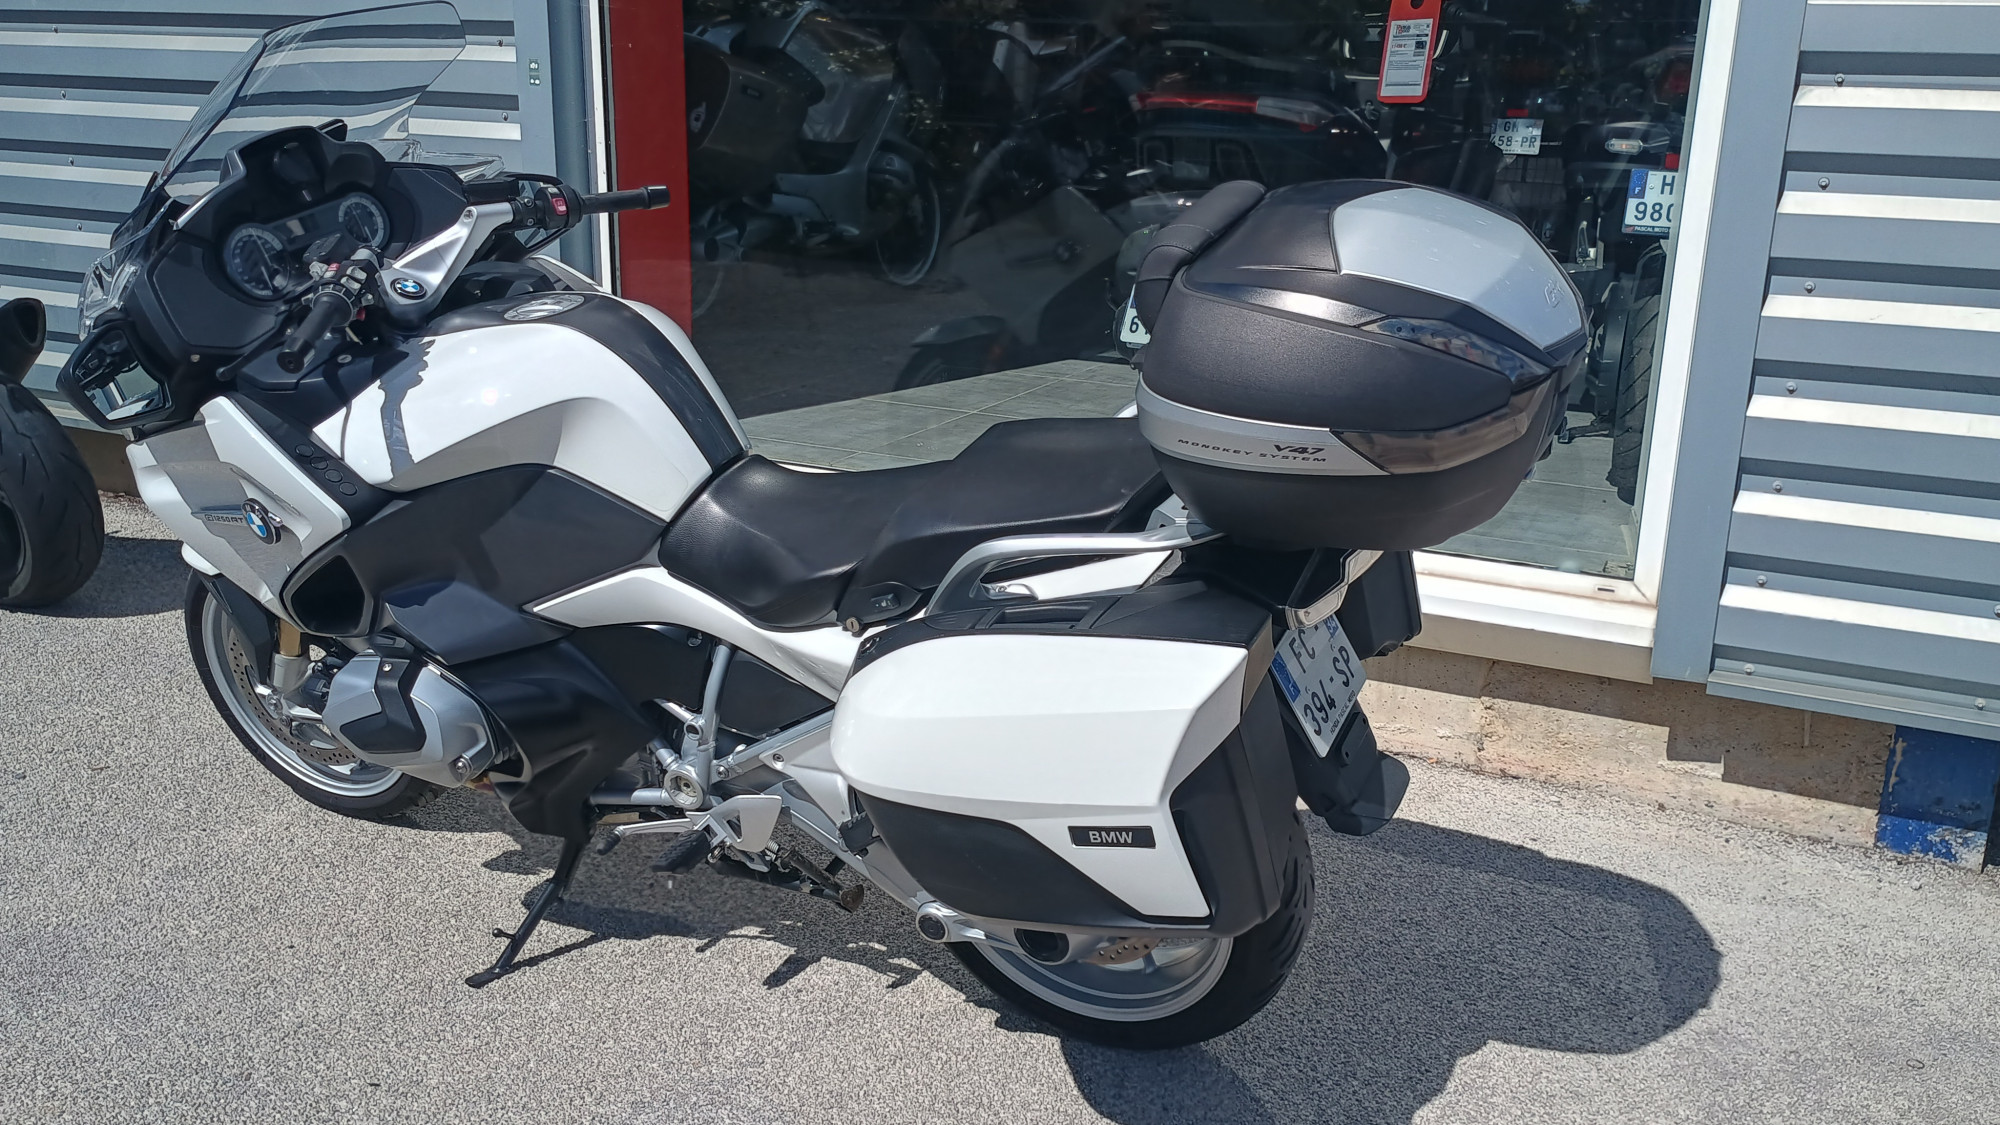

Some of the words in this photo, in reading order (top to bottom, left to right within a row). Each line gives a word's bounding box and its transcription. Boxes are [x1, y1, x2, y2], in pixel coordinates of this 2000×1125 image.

[1177, 438, 1254, 456] MONOKEY
[1259, 452, 1327, 462] SYSTEM
[1273, 444, 1326, 455] V47
[1088, 830, 1133, 844] BMW
